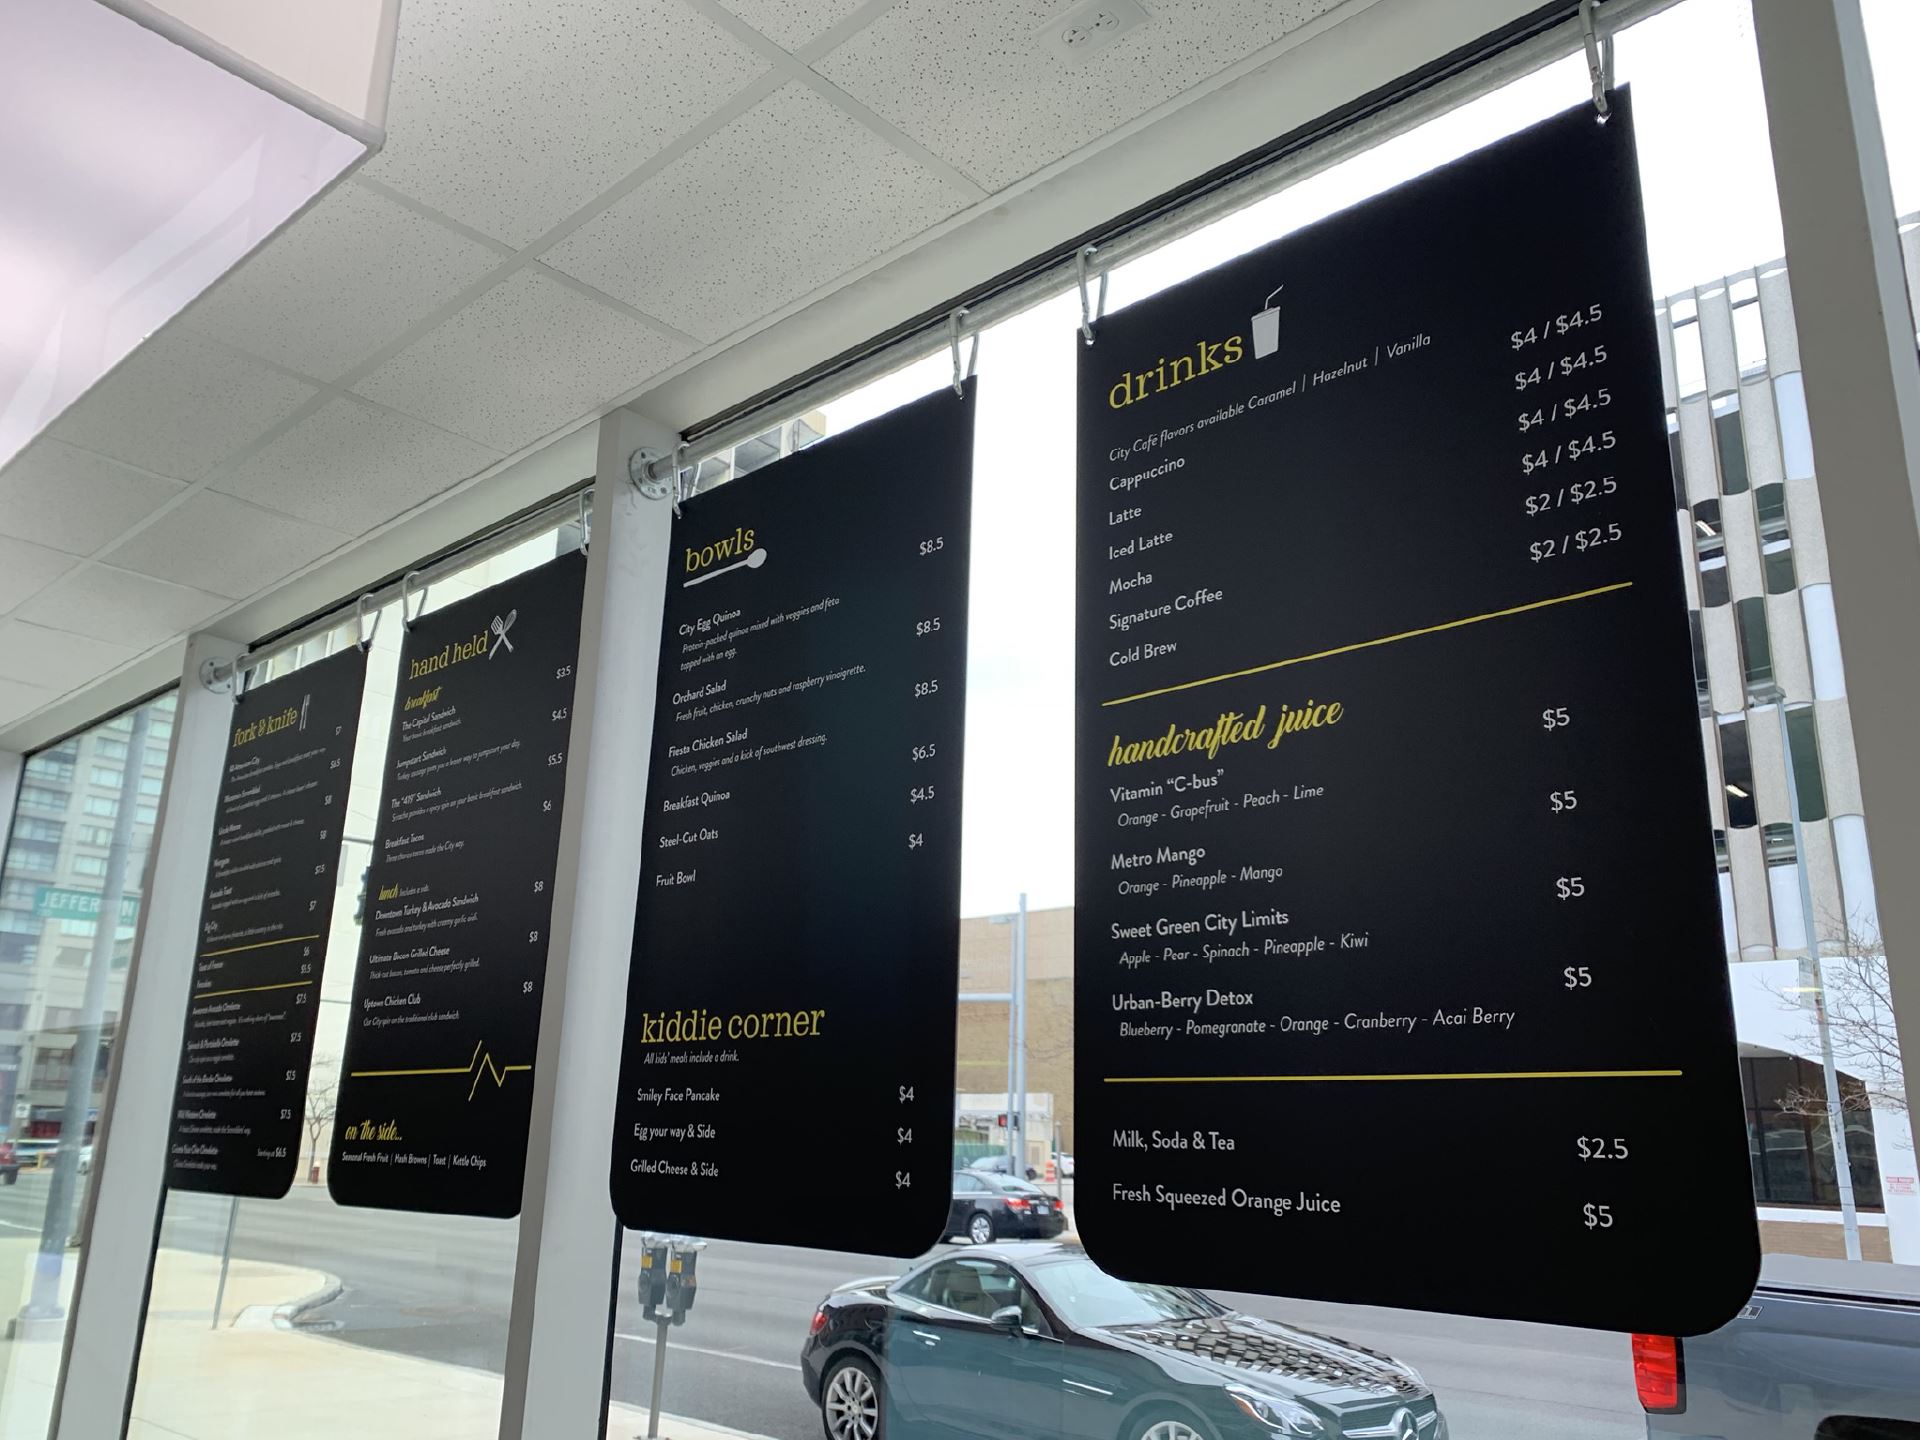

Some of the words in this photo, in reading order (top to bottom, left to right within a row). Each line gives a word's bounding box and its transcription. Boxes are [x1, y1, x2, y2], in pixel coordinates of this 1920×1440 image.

[1510, 327, 1538, 351] $4
[1555, 303, 1602, 336] $4.5
[1109, 335, 1243, 409] drinks
[1514, 367, 1542, 391] $4
[1559, 344, 1607, 376] $4.5
[1108, 447, 1131, 462] City
[1159, 423, 1194, 448] flavors
[1196, 402, 1245, 429] available
[1247, 380, 1297, 410] Caramel
[1312, 357, 1368, 386] Hazelnut
[1386, 332, 1431, 358] Vanilla
[1517, 408, 1545, 433] $4
[1563, 387, 1612, 419] $4.5
[1521, 449, 1549, 476] $4
[1567, 430, 1616, 461] $4.5
[1109, 457, 1185, 492] Cappuccino
[1525, 493, 1551, 517] $2
[1569, 475, 1617, 505] $2.5
[1108, 507, 1142, 526] Latte
[685, 527, 755, 572] bowls
[919, 536, 944, 556] $8.5
[1108, 539, 1135, 560] Iced
[1138, 532, 1174, 551] Latte
[1529, 539, 1556, 563] $2
[1574, 522, 1622, 553] $2.5
[1108, 571, 1153, 595] Mocha
[1109, 604, 1172, 632] Signature
[1174, 587, 1223, 611] Coffee
[678, 623, 696, 637] City
[696, 617, 712, 633] Egg
[712, 609, 741, 627] Quinoa
[915, 616, 941, 637] $8.5
[408, 644, 450, 681] hand
[450, 629, 489, 665] held
[1109, 645, 1140, 667] Cold
[1144, 642, 1177, 659] Brew
[555, 664, 571, 680] $3.5
[792, 675, 825, 692] raspberry
[672, 686, 705, 705] Orchard
[704, 678, 727, 696] Salad
[914, 679, 939, 698] $8.5
[551, 707, 567, 722] $4.5
[1542, 707, 1570, 732] $5
[232, 721, 258, 748] fork
[265, 706, 298, 735] knife
[1107, 704, 1266, 767] handcrafted
[1266, 698, 1344, 750] juice
[667, 745, 691, 758] Fiesta
[691, 735, 724, 752] Chicken
[725, 727, 748, 744] Salad
[739, 747, 754, 761] kick
[754, 745, 764, 761] of
[911, 743, 936, 763] $6.5
[547, 751, 563, 766] $5.5
[662, 795, 700, 812] Breakfast
[700, 790, 731, 807] Quinoa
[909, 785, 935, 804] $4.5
[1109, 780, 1163, 803] Vitamin
[1549, 789, 1578, 814] $5
[542, 799, 552, 812] $6
[1117, 812, 1159, 828] Orange
[1170, 796, 1230, 822] Grapefruit
[1242, 788, 1280, 809] Peach
[1293, 784, 1324, 800] Lime
[658, 831, 698, 849] Steel-Cut
[698, 827, 719, 841] Oats
[908, 832, 924, 850] $4
[1110, 852, 1153, 870] Metro
[1156, 846, 1206, 866] Mango
[533, 880, 544, 893] $8
[655, 873, 675, 887] Fruit
[675, 868, 697, 885] Bowl
[1117, 880, 1160, 897] Orange
[1171, 869, 1227, 890] Pineapple
[1239, 865, 1283, 884] Mango
[1555, 876, 1585, 901] $5
[377, 882, 399, 901] lunch
[403, 904, 422, 918] Turkey
[451, 892, 479, 908] Sandwich
[1111, 922, 1153, 940] Sweet
[1155, 917, 1201, 936] Green
[1204, 913, 1238, 936] City
[1241, 908, 1289, 928] Limits
[528, 930, 539, 944] $8
[428, 945, 451, 957] Cheese
[1118, 949, 1151, 970] Apple
[1162, 947, 1190, 961] Pear
[1202, 940, 1250, 964] Spinach
[1263, 935, 1326, 957] Pineapple
[1340, 931, 1369, 949] Kiwi
[522, 980, 533, 994] $8
[1563, 965, 1592, 991] $5
[383, 995, 407, 1007] Chicken
[407, 992, 421, 1005] Club
[1111, 990, 1203, 1014] Urban-Berry
[1206, 988, 1253, 1006] Detox
[640, 1008, 722, 1044] kiddie
[727, 1009, 826, 1040] corner
[1119, 1021, 1174, 1041] Blueberry
[1185, 1018, 1267, 1038] Pomegranate
[1280, 1015, 1329, 1036] Orange
[1343, 1011, 1417, 1034] Cranberry
[1432, 1008, 1466, 1026] Acai
[1472, 1006, 1515, 1030] Berry
[636, 1087, 663, 1107] Smiley
[664, 1087, 684, 1102] Face
[685, 1087, 720, 1102] Pancake
[898, 1085, 915, 1104] $4
[359, 1119, 376, 1141] the
[633, 1122, 649, 1142] Egg
[648, 1127, 669, 1141] your
[669, 1127, 687, 1143] way
[686, 1123, 695, 1138] &
[696, 1123, 716, 1139] Side
[896, 1127, 913, 1145] $4
[1112, 1129, 1148, 1153] Milk,
[1151, 1130, 1188, 1149] Soda
[1192, 1130, 1206, 1150] &
[1208, 1131, 1235, 1151] Tea
[1576, 1135, 1629, 1162] $2.5
[469, 1154, 487, 1171] Chips
[629, 1158, 657, 1174] Grilled
[657, 1159, 689, 1176] Cheese
[689, 1161, 699, 1176] &
[700, 1161, 719, 1177] Side
[895, 1170, 911, 1190] $4
[1112, 1182, 1151, 1202] Fresh
[1155, 1184, 1227, 1211] Squeezed
[1231, 1187, 1292, 1217] Orange
[1295, 1191, 1341, 1213] Juice
[1583, 1202, 1613, 1230] $5
